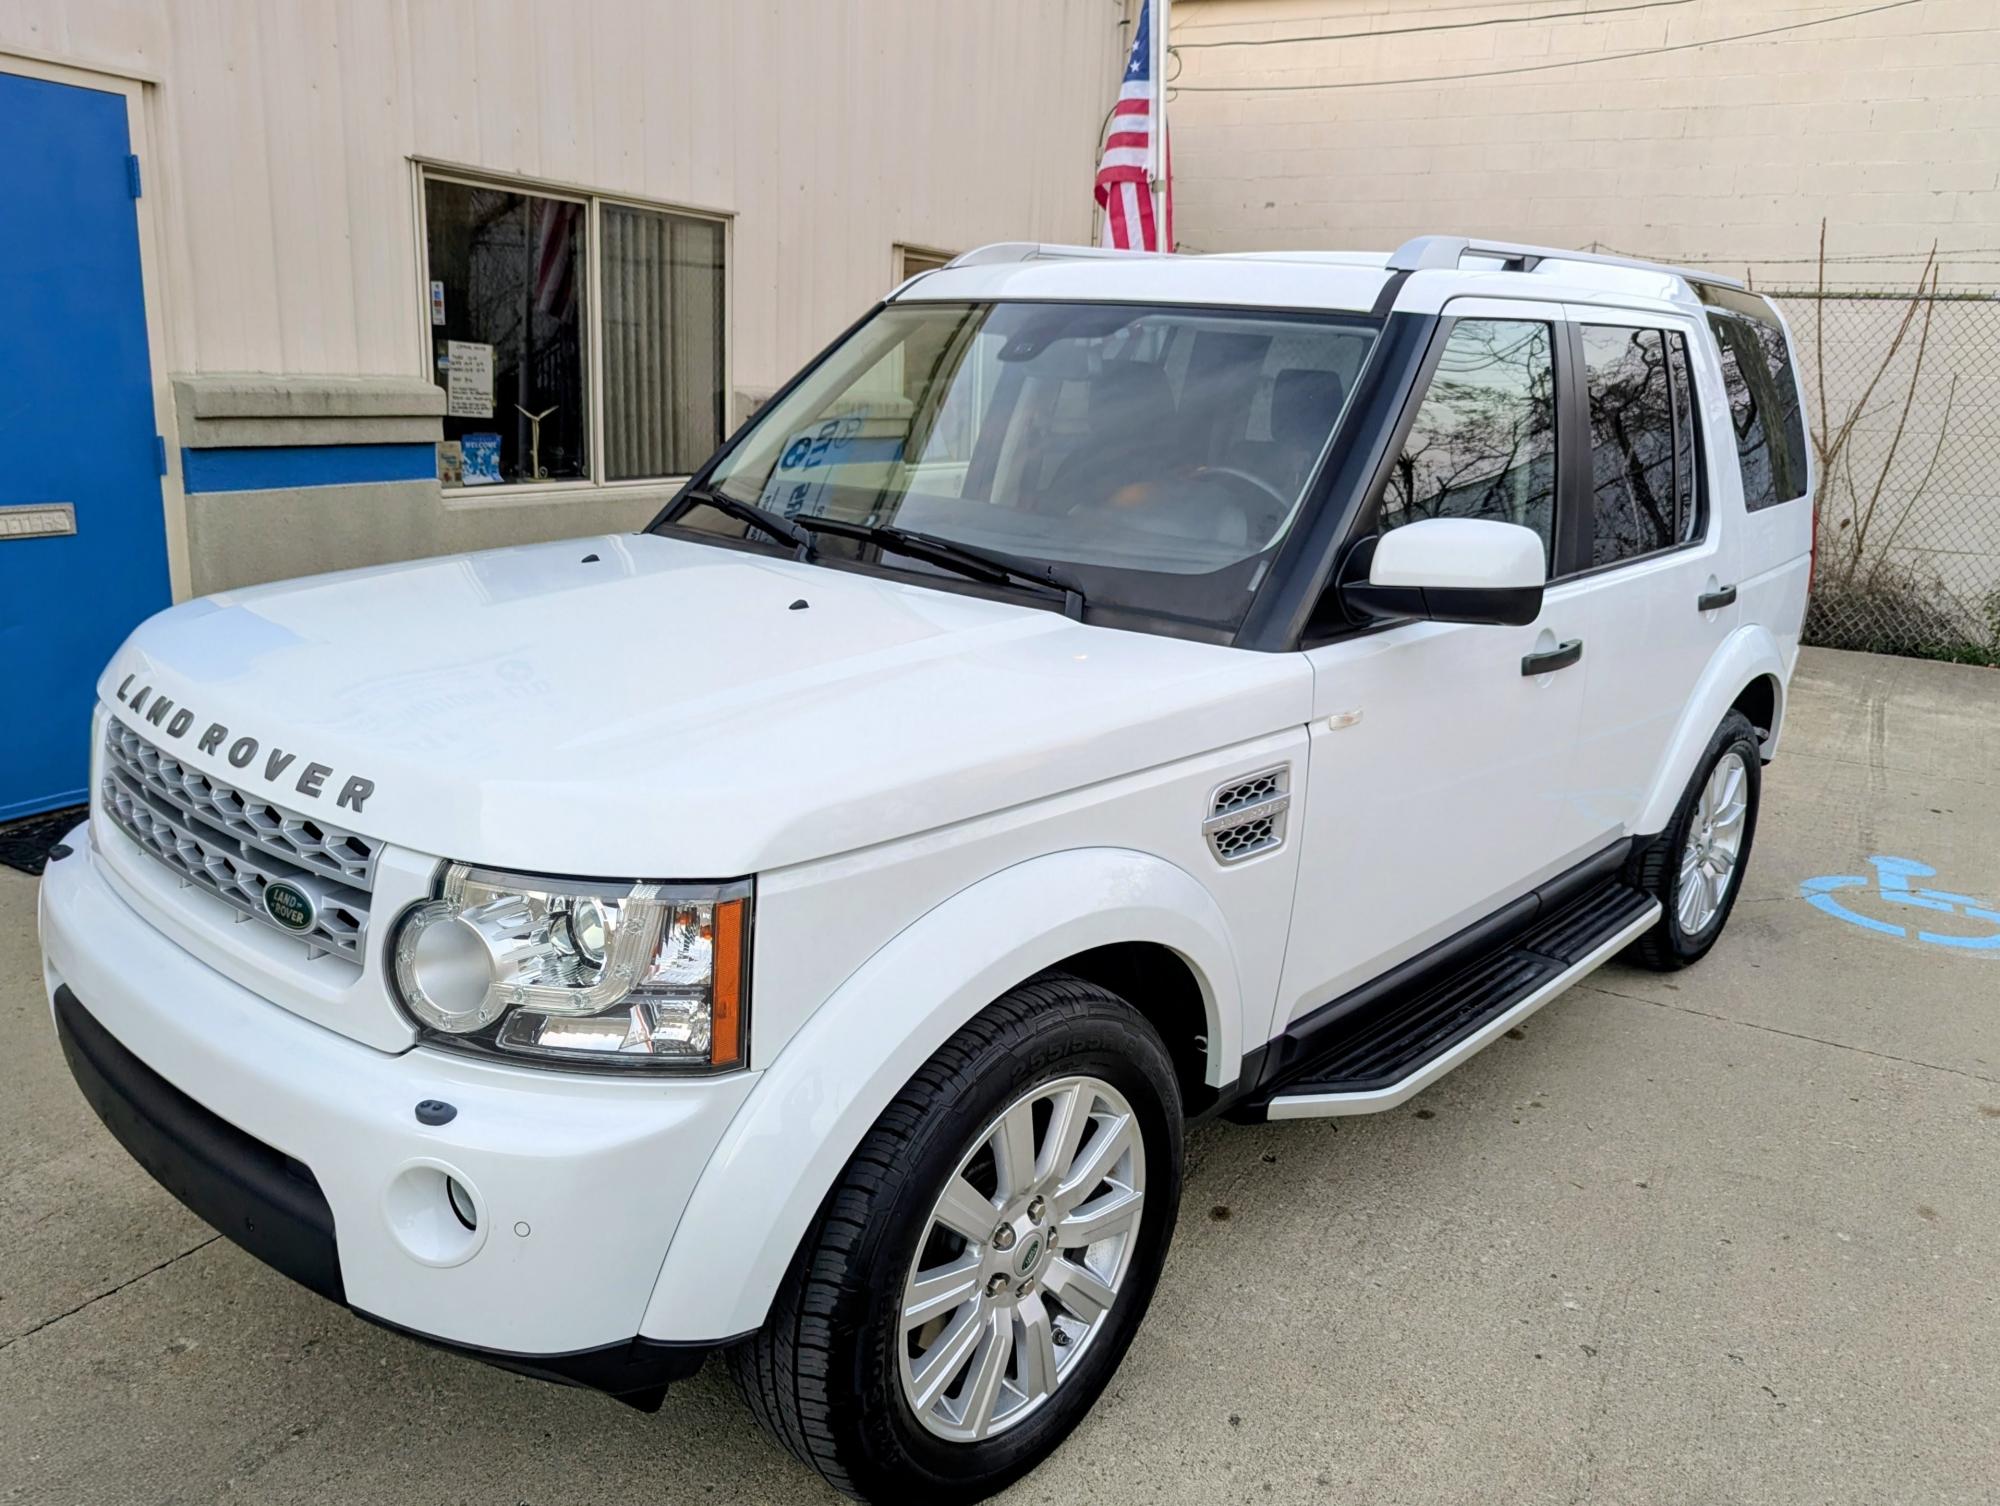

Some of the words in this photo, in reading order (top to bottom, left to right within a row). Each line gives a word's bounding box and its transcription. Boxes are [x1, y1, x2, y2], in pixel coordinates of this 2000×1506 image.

[465, 441, 497, 449] WELCOME
[117, 673, 195, 739] LAND
[197, 722, 375, 813] ROVER
[273, 888, 297, 908] LAND
[274, 902, 305, 924] ROVER
